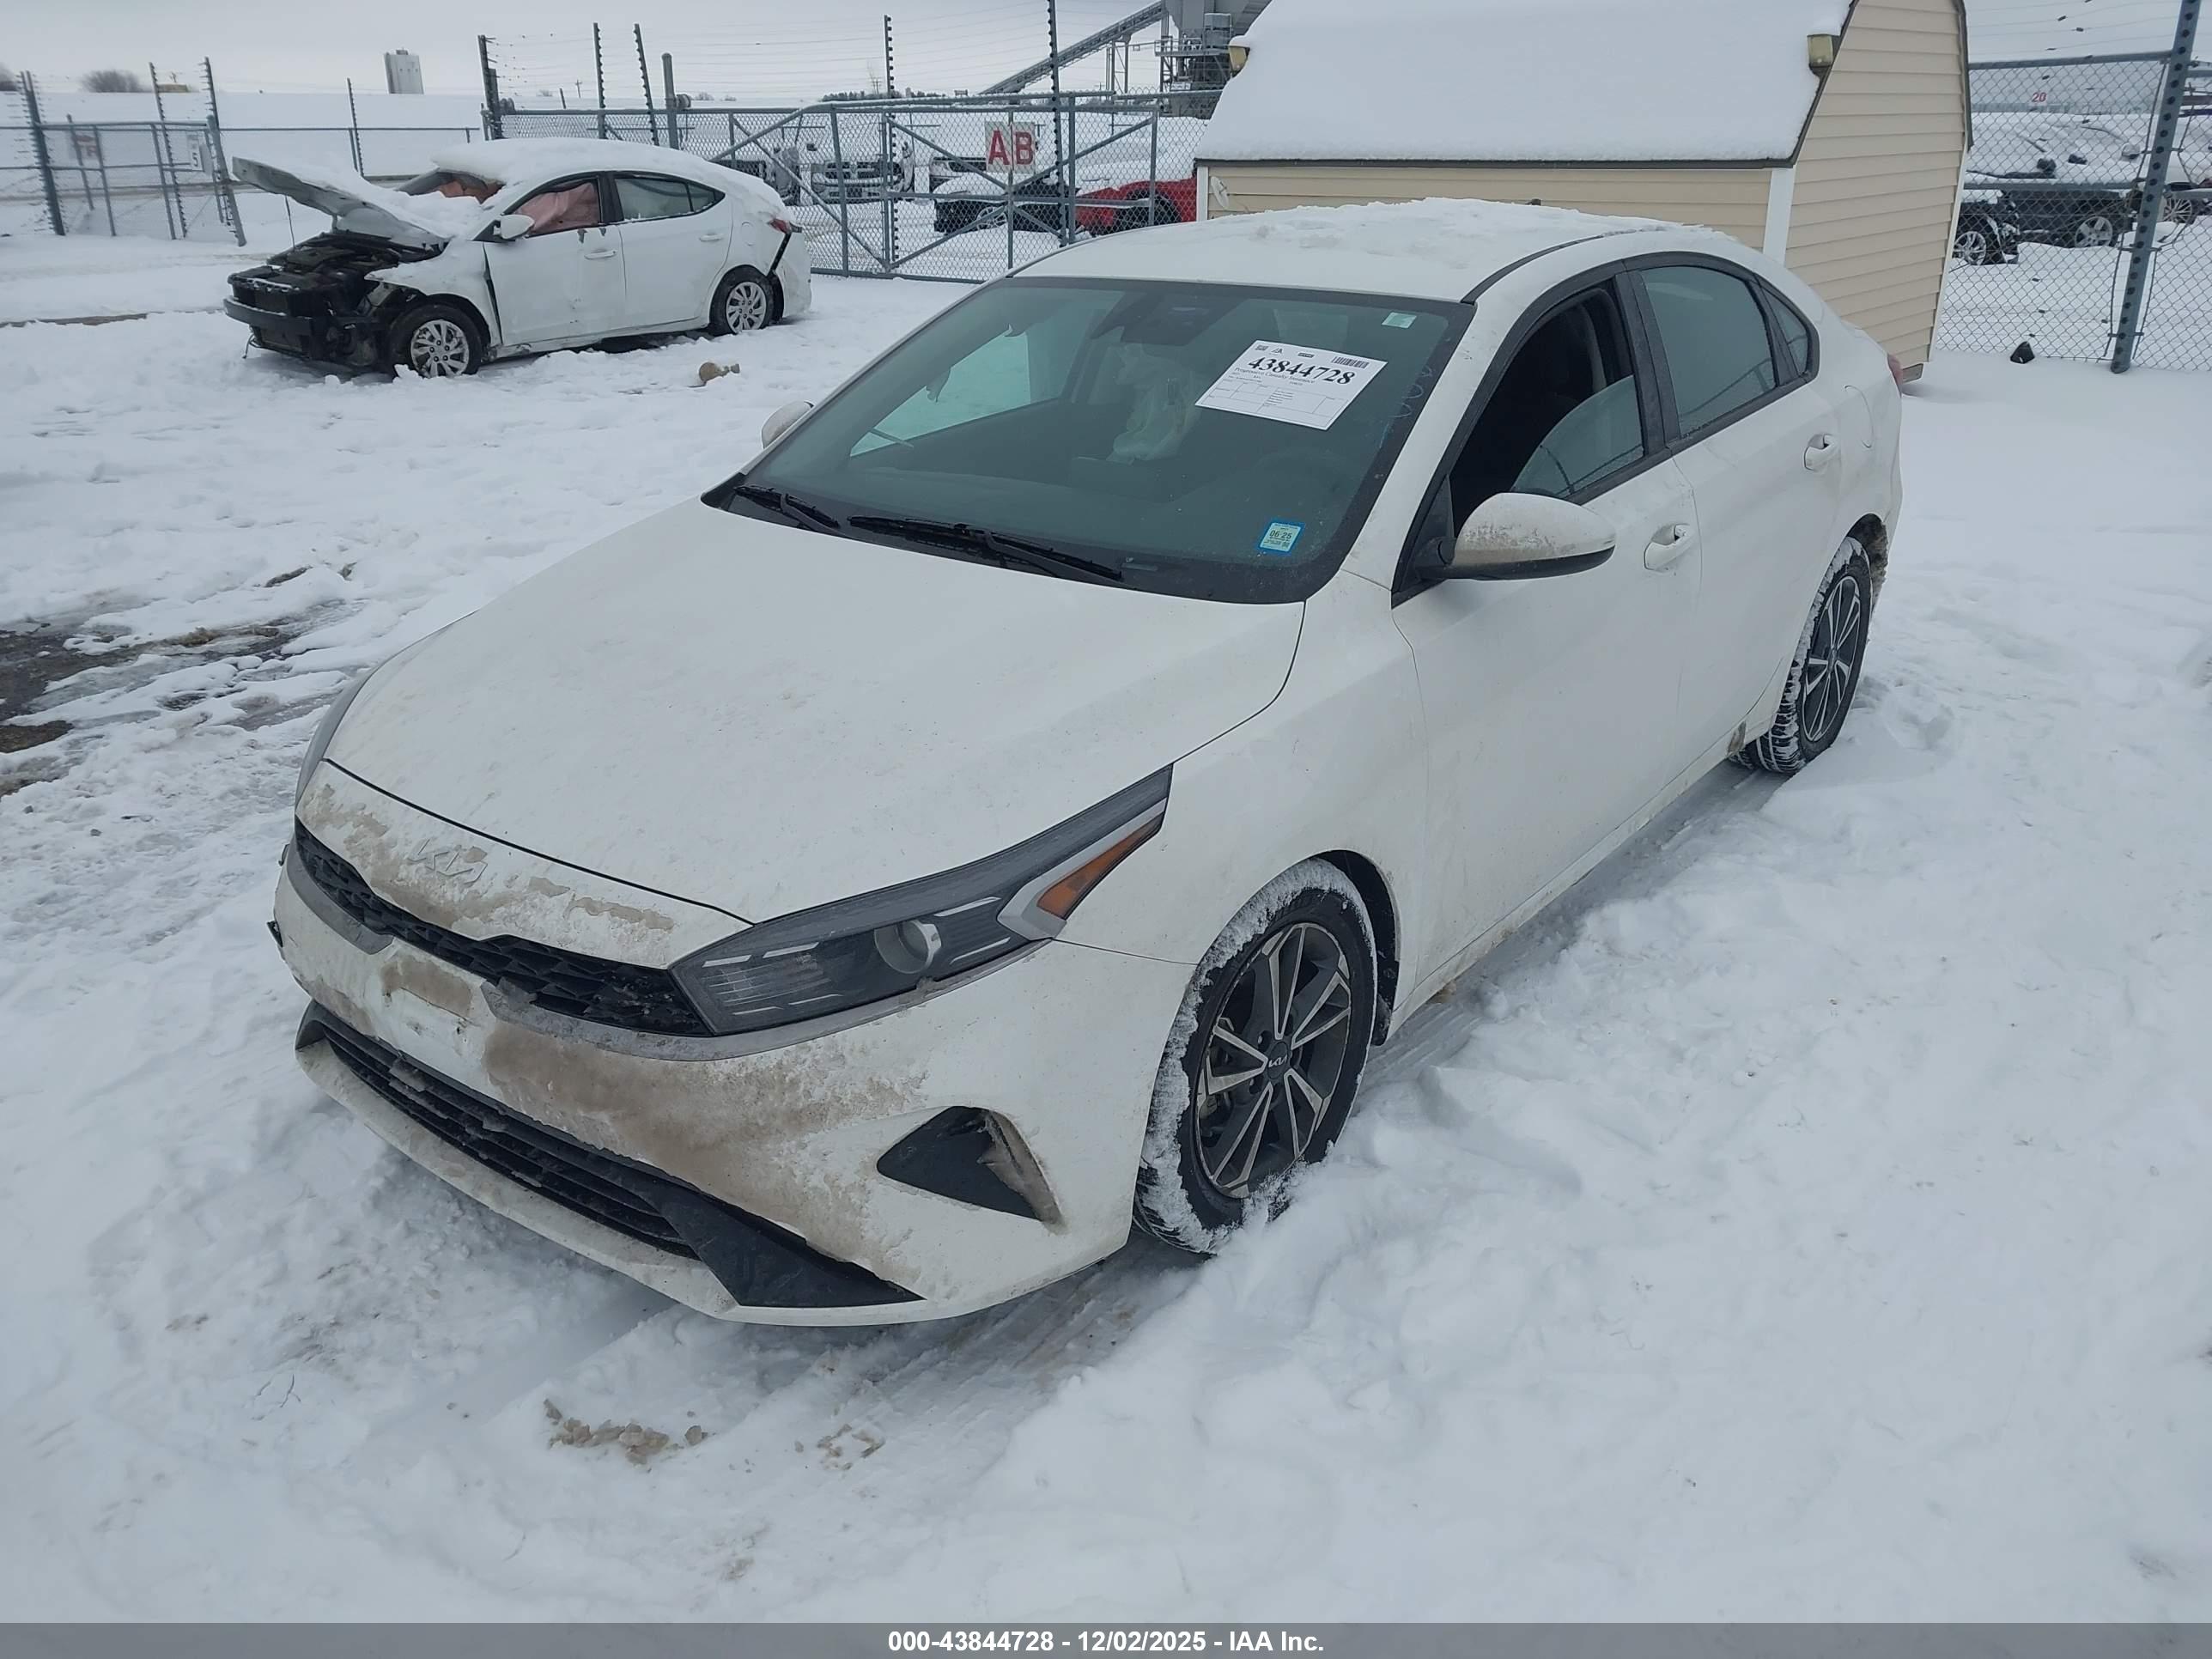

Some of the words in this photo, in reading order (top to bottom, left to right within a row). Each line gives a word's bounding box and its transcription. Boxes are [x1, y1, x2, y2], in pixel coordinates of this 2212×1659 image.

[2032, 92, 2047, 102] 20
[191, 152, 198, 167] 5
[1248, 356, 1356, 385] 43844728
